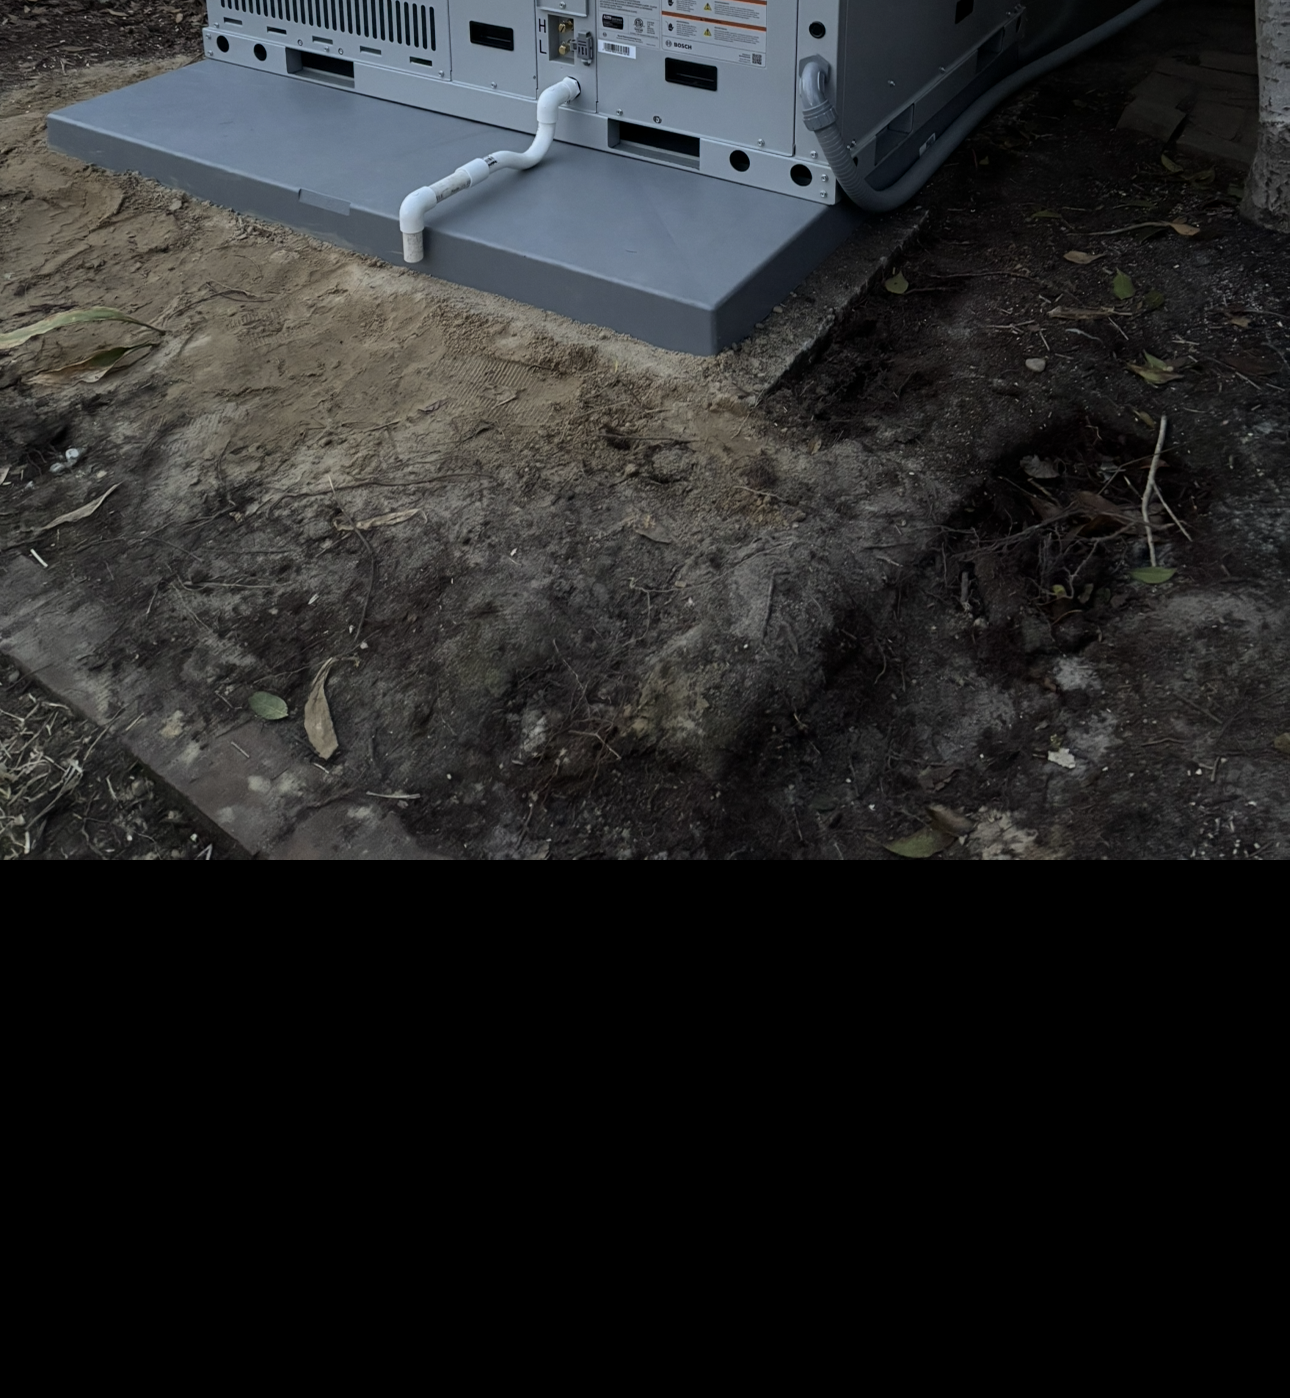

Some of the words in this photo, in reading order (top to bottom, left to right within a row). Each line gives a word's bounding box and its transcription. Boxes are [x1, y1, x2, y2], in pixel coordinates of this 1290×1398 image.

[538, 18, 546, 33] H
[539, 39, 547, 54] L
[673, 42, 692, 50] BOSCH
